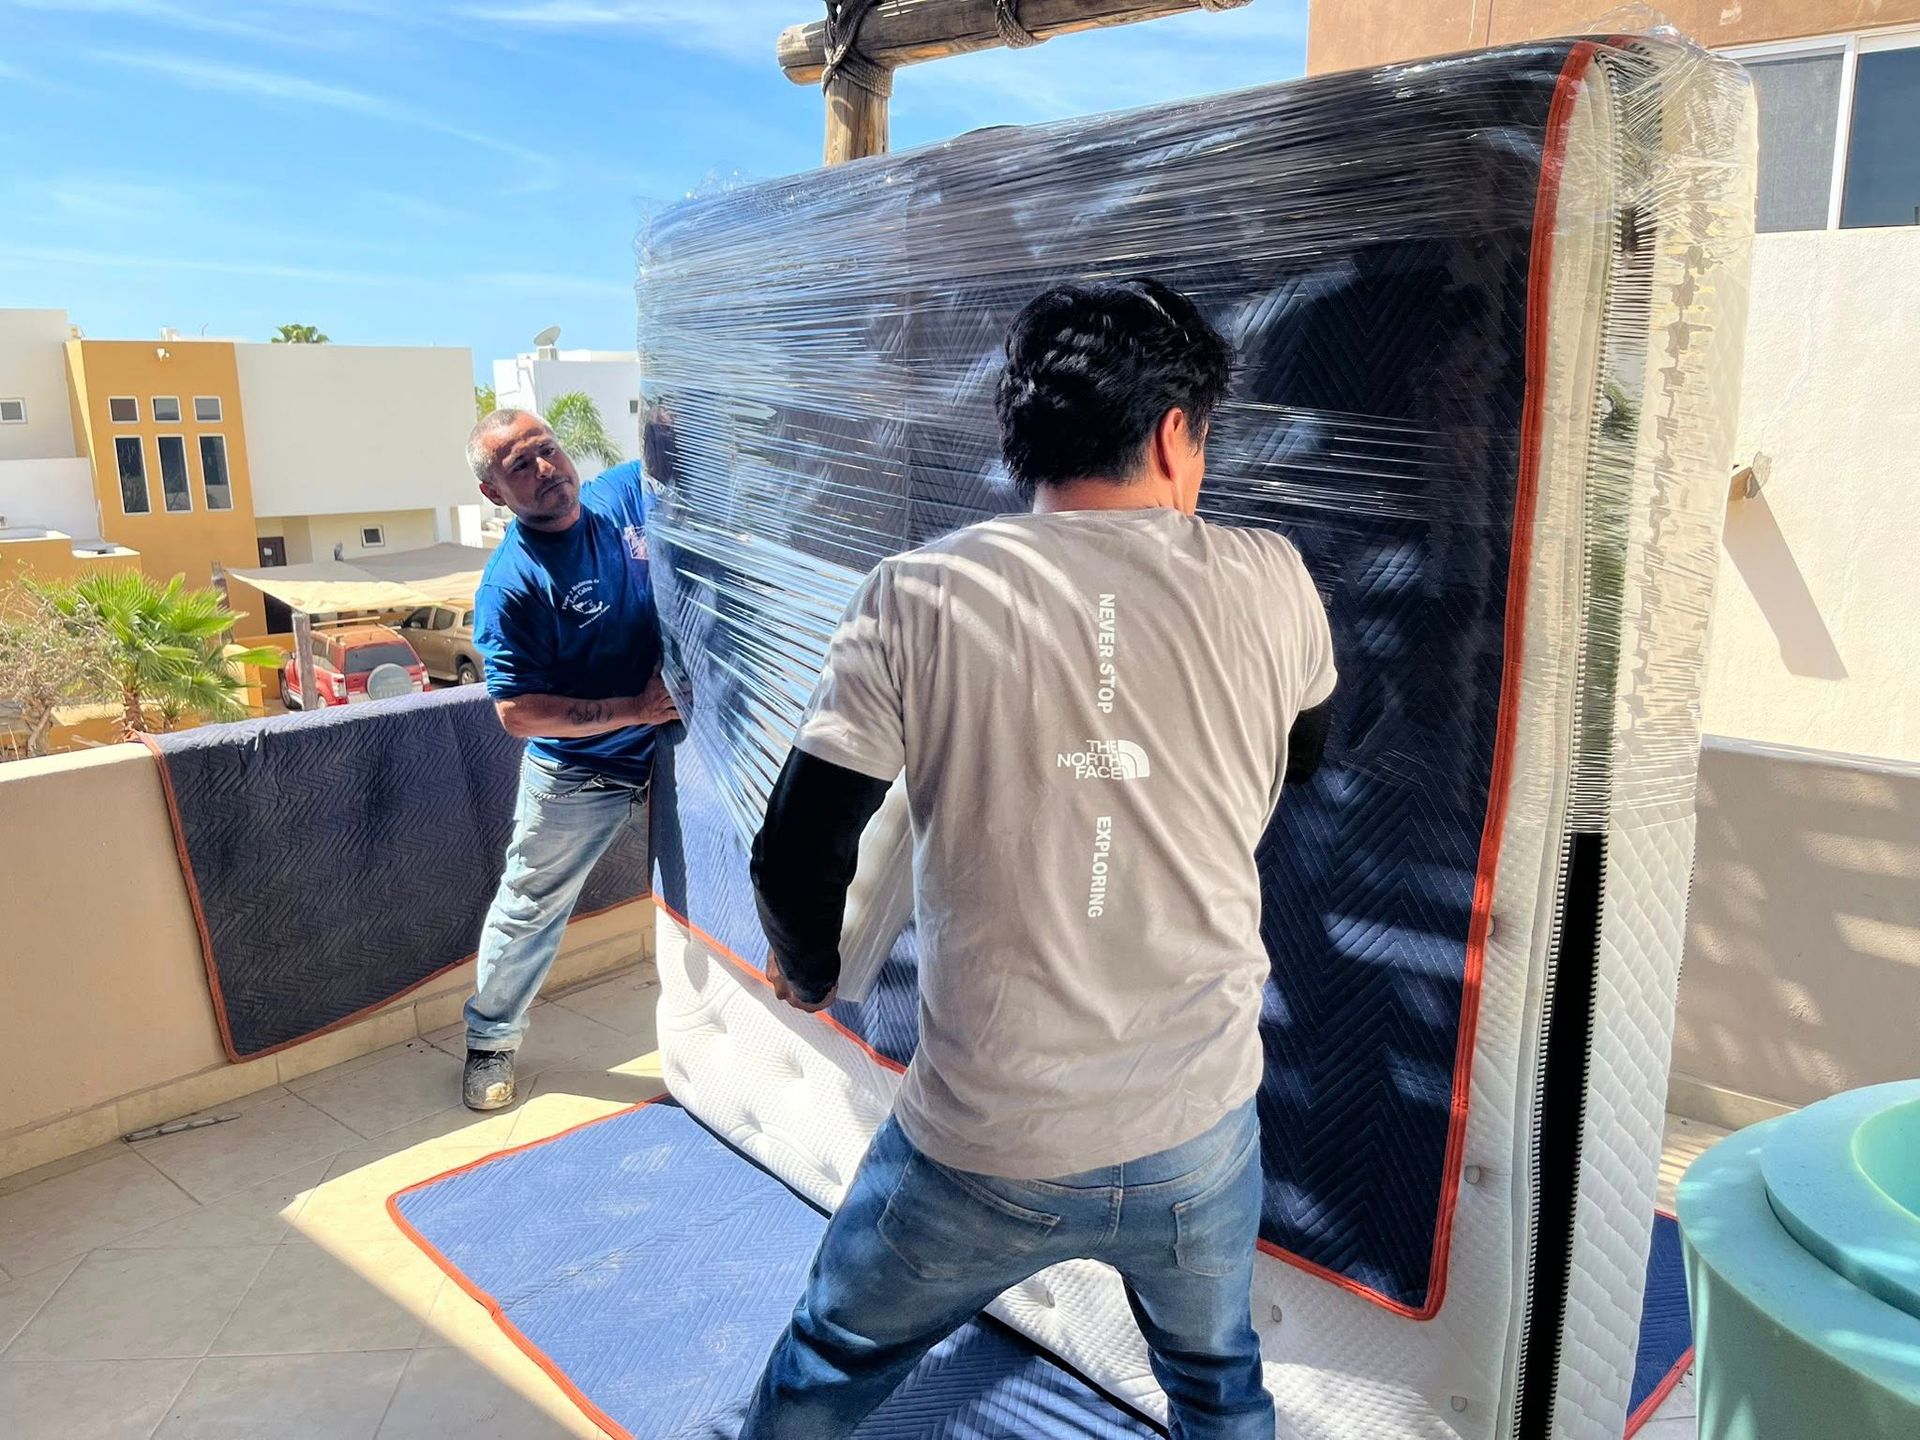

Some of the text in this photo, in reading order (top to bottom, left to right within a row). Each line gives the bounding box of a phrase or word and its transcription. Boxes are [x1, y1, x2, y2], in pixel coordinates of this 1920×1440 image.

[1097, 593, 1116, 714] NEVER STOP
[1085, 739, 1117, 754] THE
[1057, 751, 1120, 768] NORTH
[1075, 764, 1123, 780] FACE
[1087, 816, 1112, 918] EXPLORING
